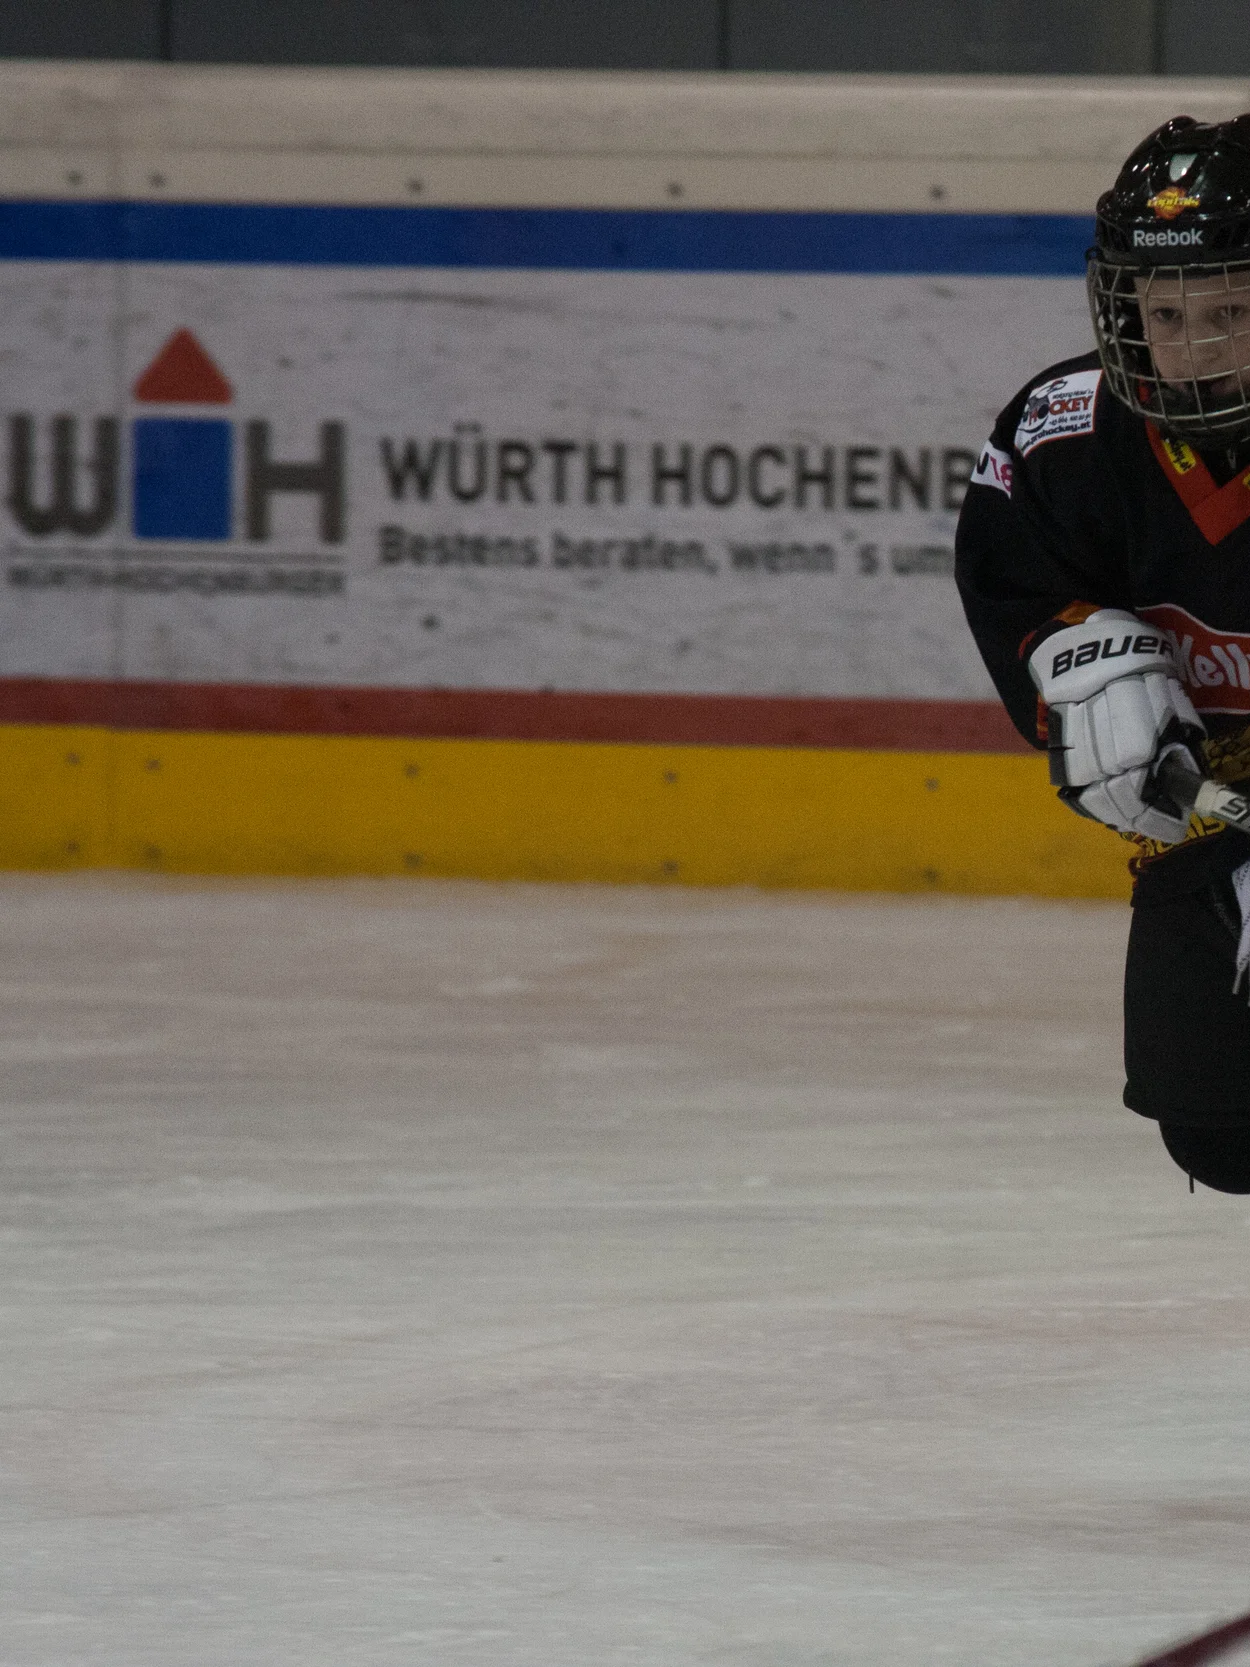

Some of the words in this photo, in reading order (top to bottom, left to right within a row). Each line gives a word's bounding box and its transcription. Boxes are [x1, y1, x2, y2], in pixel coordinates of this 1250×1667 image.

[1133, 229, 1204, 248] Reebok
[378, 421, 626, 503] WÜRTH
[652, 440, 977, 513] HOCHENB
[378, 524, 541, 568] Bestens
